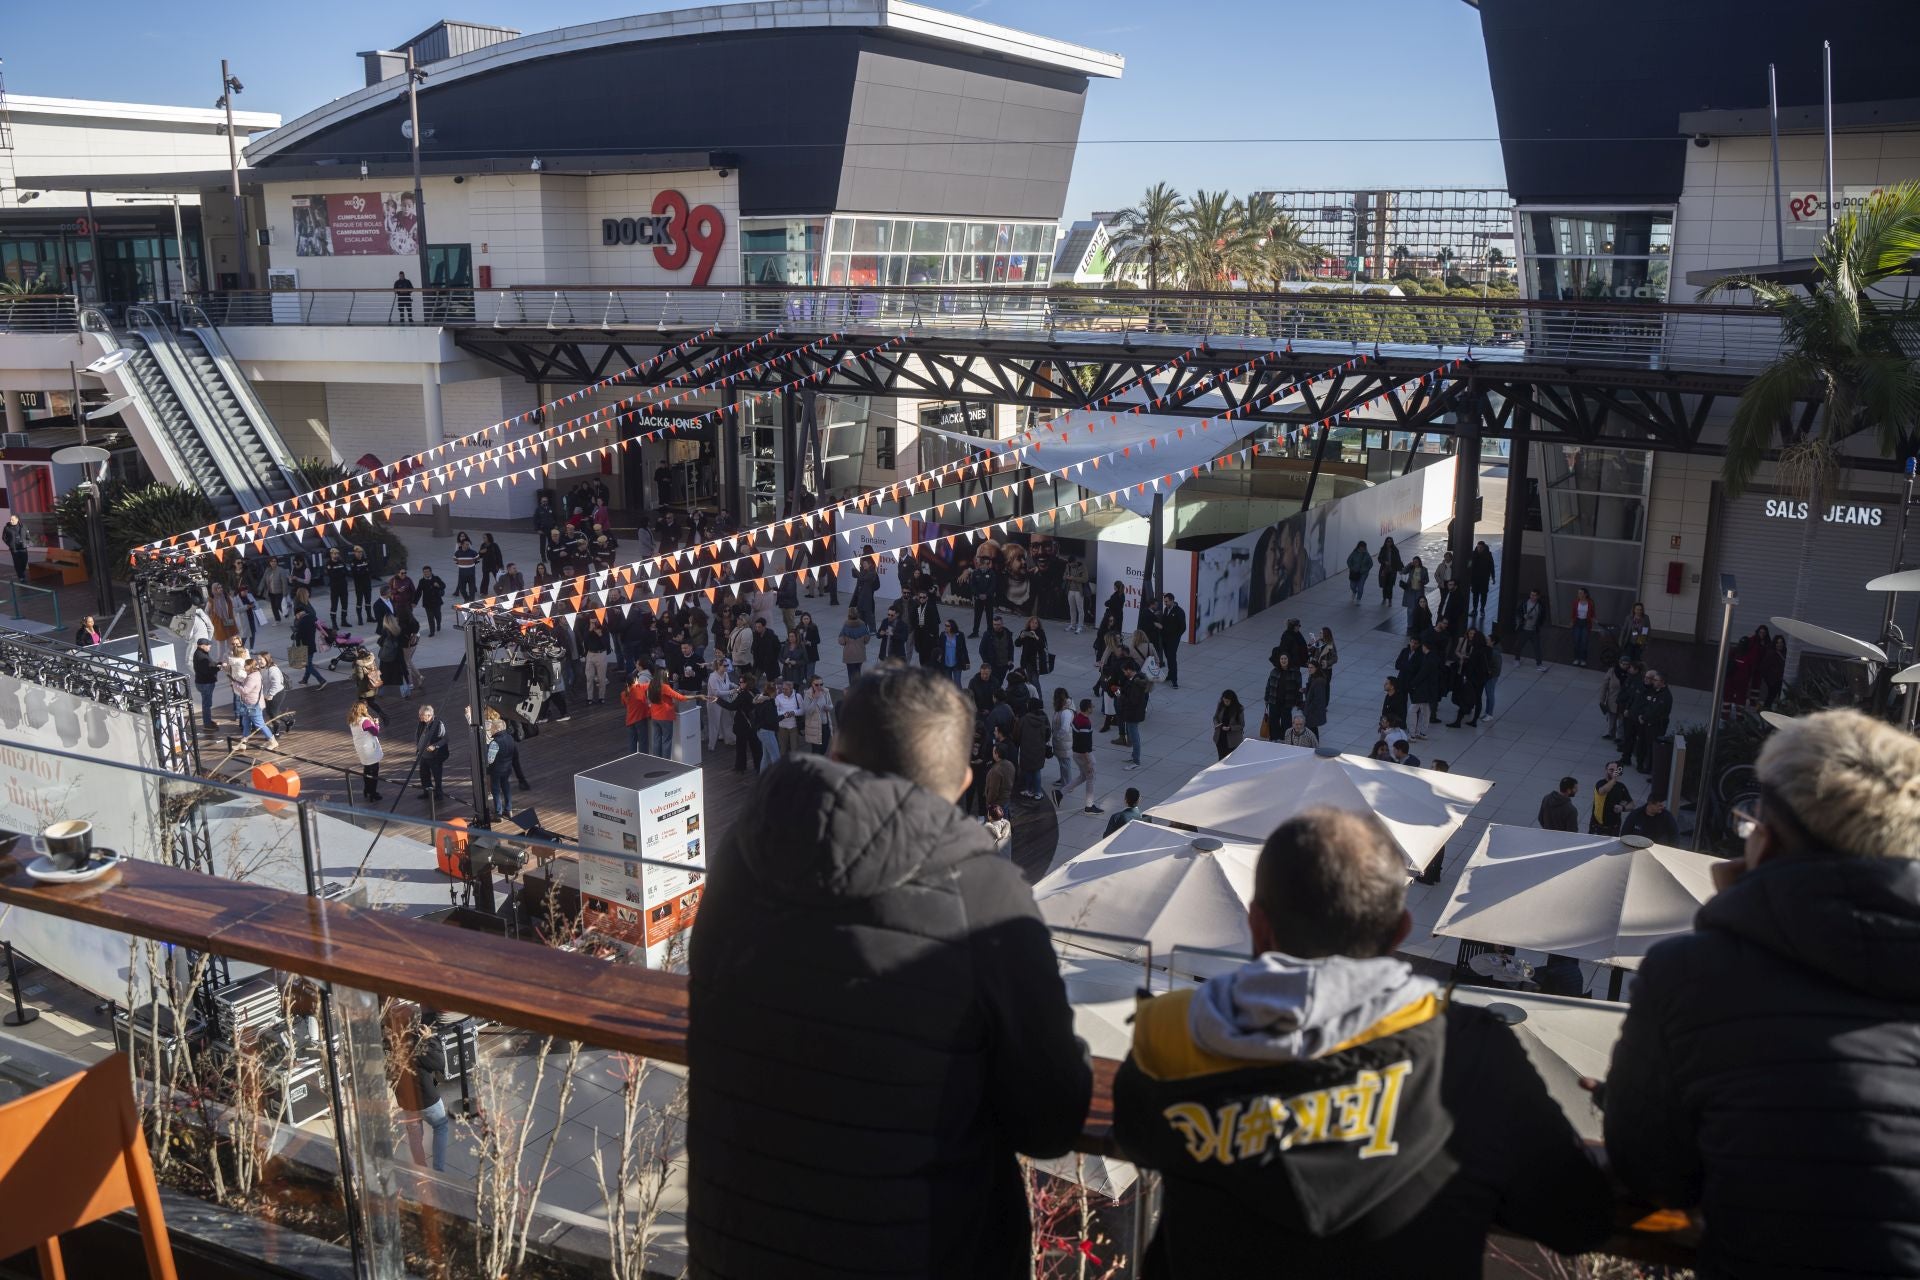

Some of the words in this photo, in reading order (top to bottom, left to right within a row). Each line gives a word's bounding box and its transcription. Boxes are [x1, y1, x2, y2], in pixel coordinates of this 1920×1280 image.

[602, 217, 673, 246] DOCK
[651, 189, 726, 286] 39
[1081, 235, 1100, 273] LEROY
[1347, 260, 1358, 268] A2
[940, 408, 988, 426] JACK&ONES
[1765, 499, 1809, 520] SALS
[1823, 504, 1882, 526] JEANS
